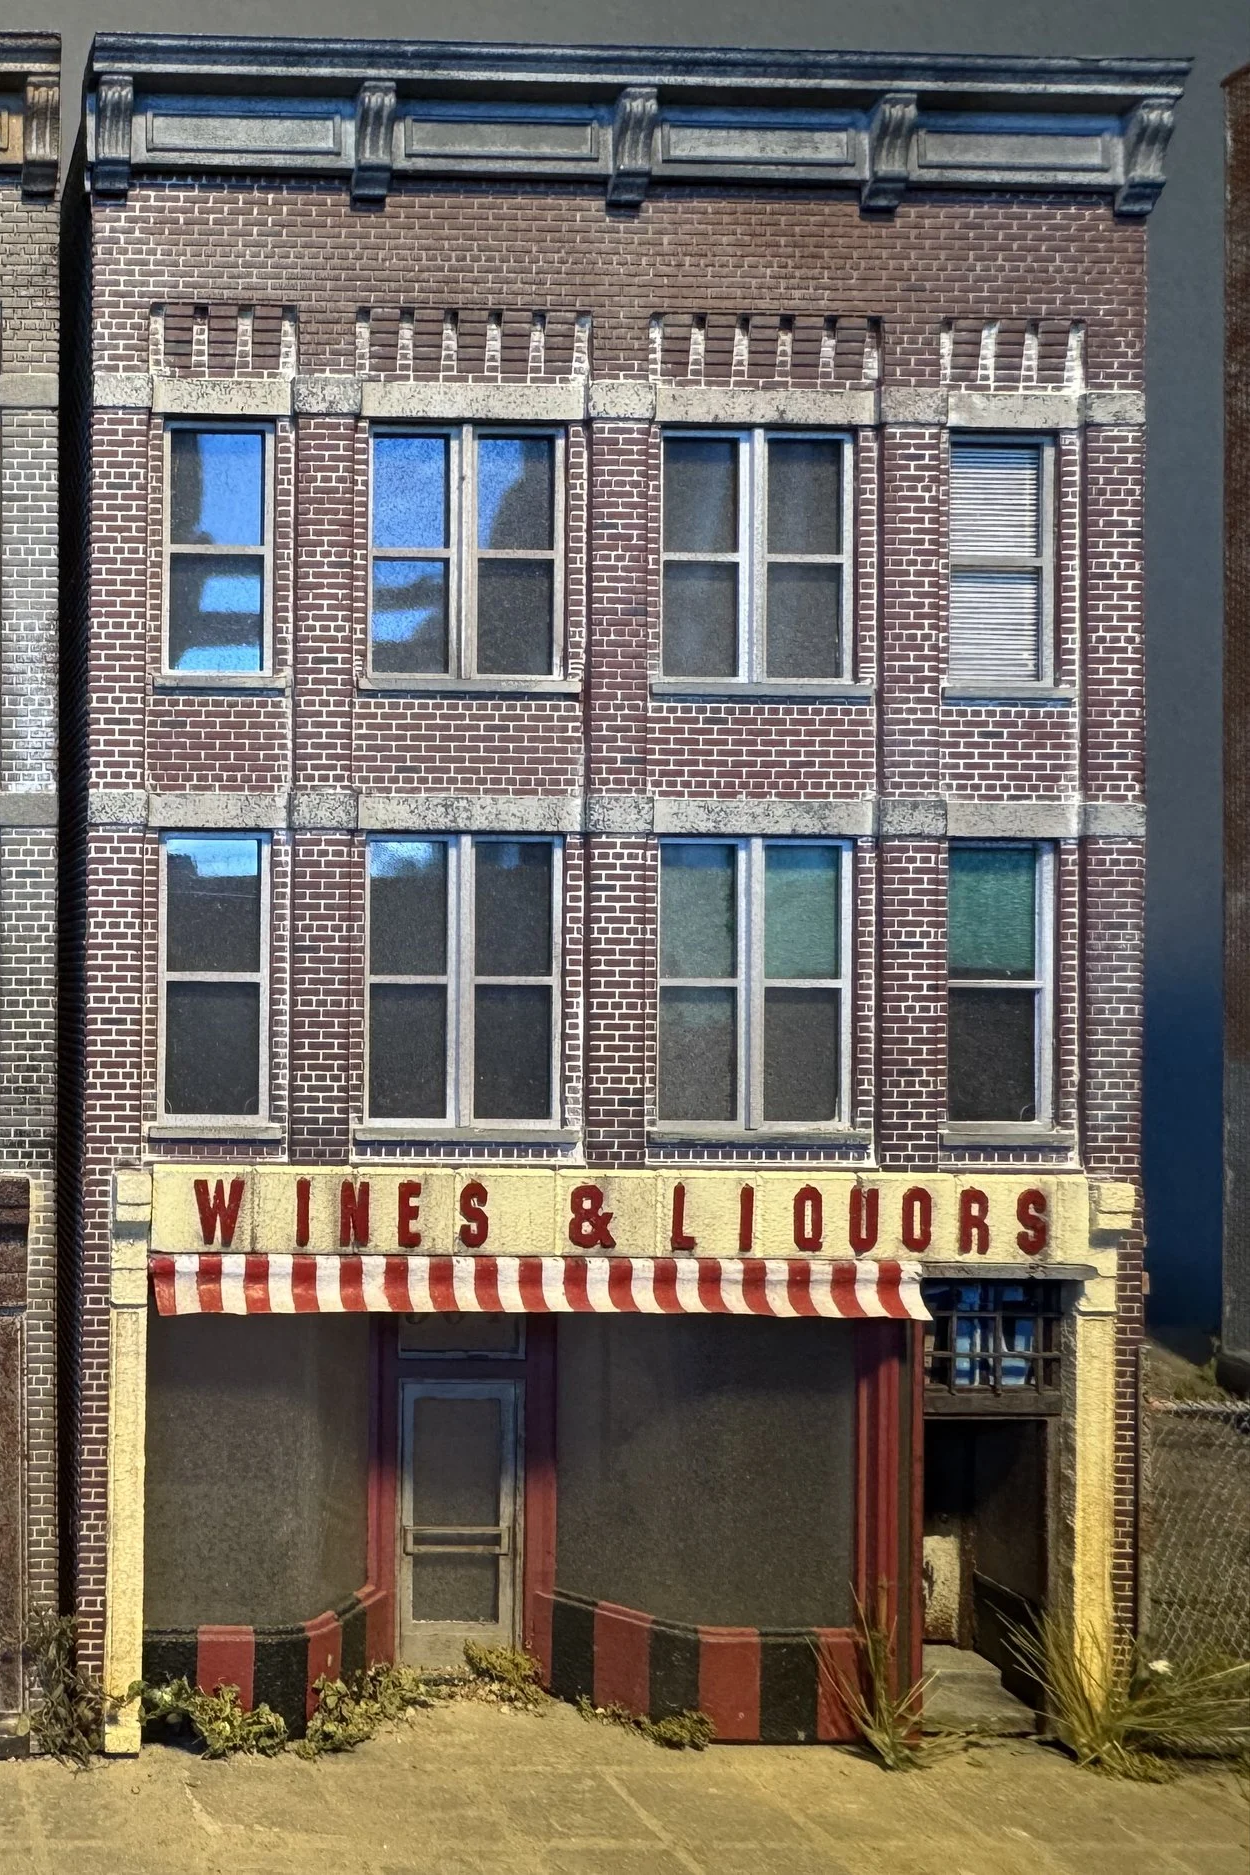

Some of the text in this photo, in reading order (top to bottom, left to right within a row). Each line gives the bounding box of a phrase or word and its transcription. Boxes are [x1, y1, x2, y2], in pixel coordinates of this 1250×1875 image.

[194, 1178, 1049, 1255] WINES & LIQUORS
